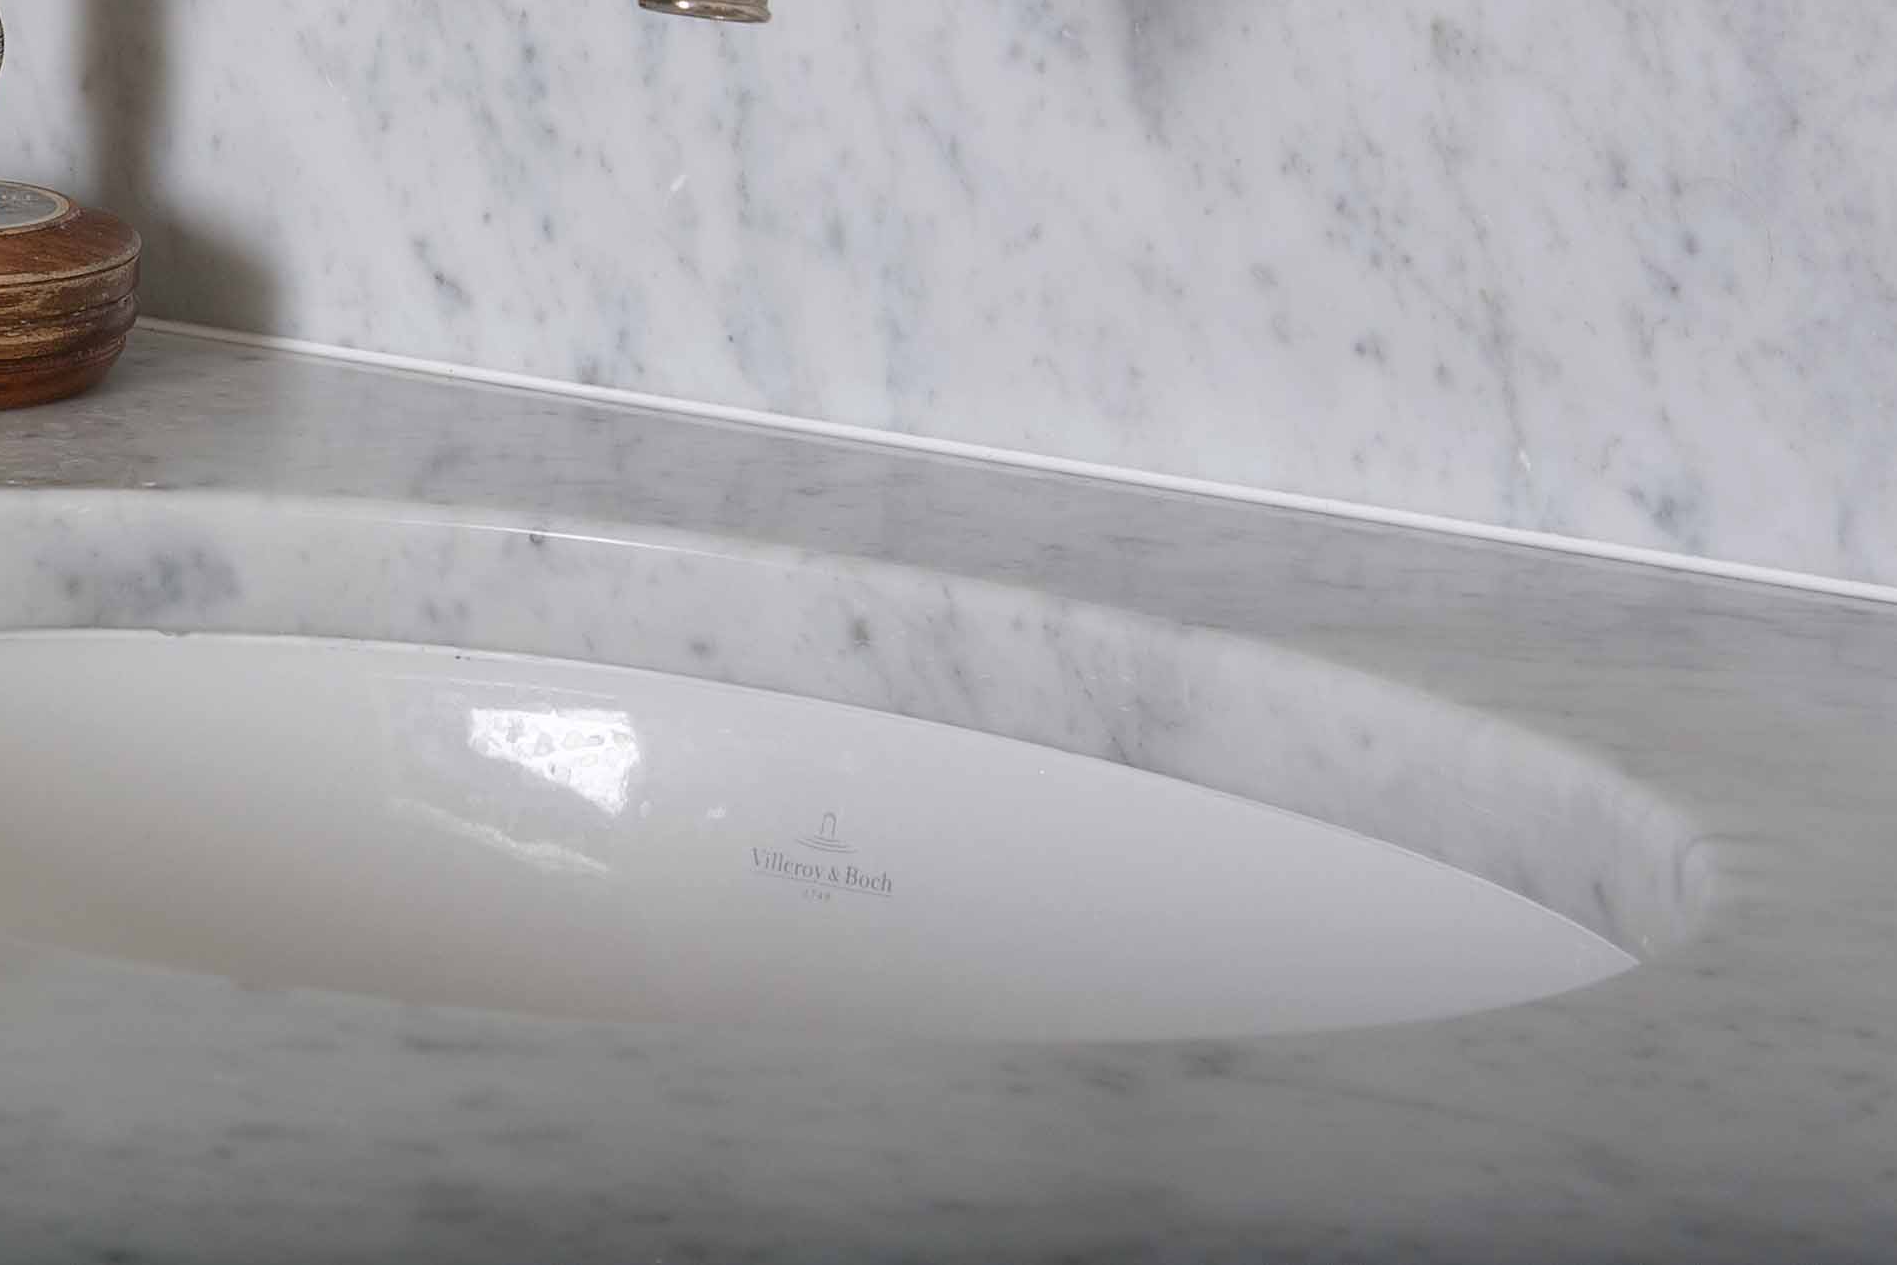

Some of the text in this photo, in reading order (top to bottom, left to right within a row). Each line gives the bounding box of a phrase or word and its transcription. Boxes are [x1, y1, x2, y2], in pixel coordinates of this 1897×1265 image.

[750, 846, 892, 893] Villeroy & Boch
